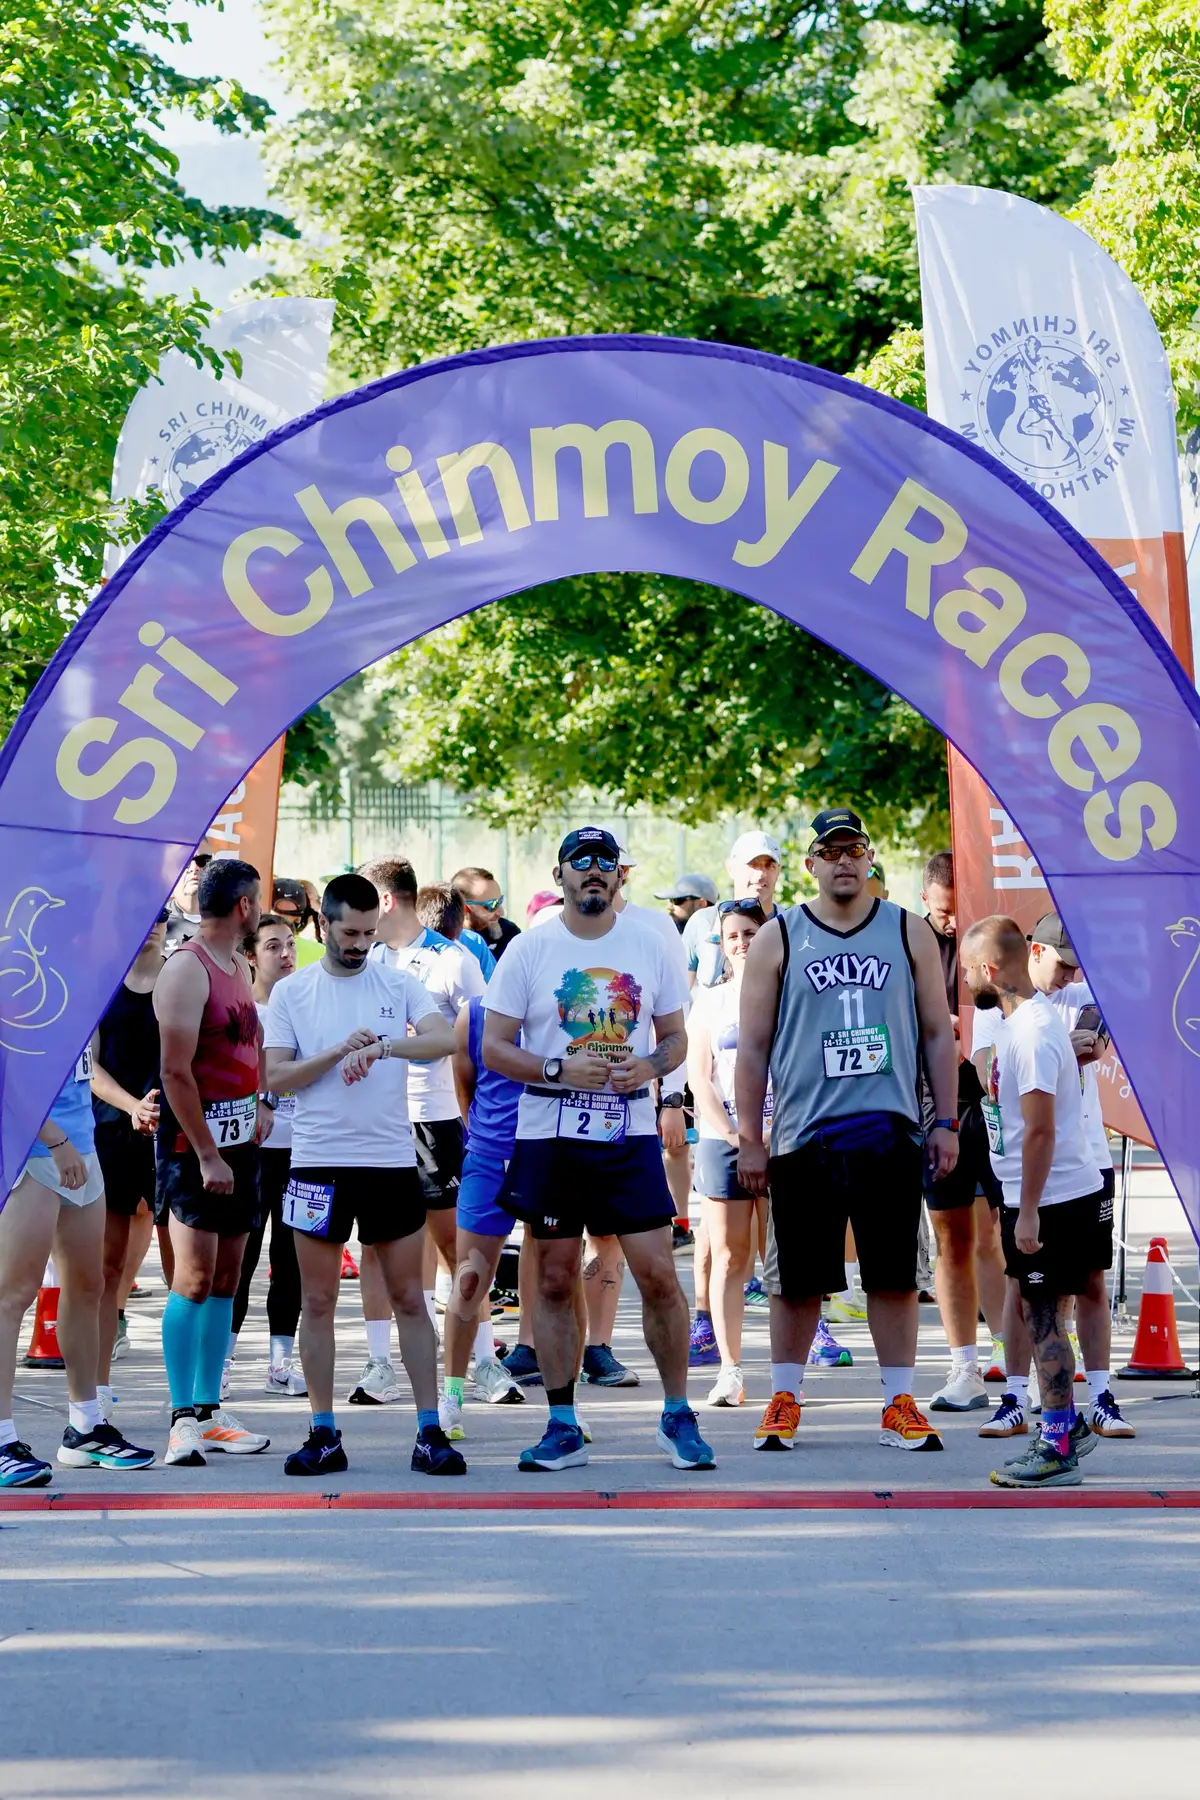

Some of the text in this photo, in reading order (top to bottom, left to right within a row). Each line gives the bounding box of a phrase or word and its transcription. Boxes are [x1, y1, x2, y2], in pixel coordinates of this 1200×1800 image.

[159, 401, 275, 442] SRI CHINM
[56, 419, 1178, 861] Sri Chinmoy Races
[804, 953, 891, 994] BKLYN
[838, 989, 865, 1029] 11
[850, 1027, 878, 1037] CHINMOY
[851, 1036, 869, 1044] HOUR
[870, 1034, 886, 1042] RACE
[837, 1048, 863, 1072] 72
[562, 1098, 625, 1111] 24-12-6 HOUR RACE
[578, 1092, 590, 1100] SRI
[591, 1094, 620, 1103] CHINMOY
[205, 1108, 232, 1118] 24-12-6
[576, 1112, 591, 1135] 2
[218, 1118, 240, 1143] 73
[296, 1188, 313, 1200] HOUR
[313, 1192, 331, 1202] RACE
[297, 1181, 326, 1194] CHINMOY
[290, 1199, 296, 1222] 1
